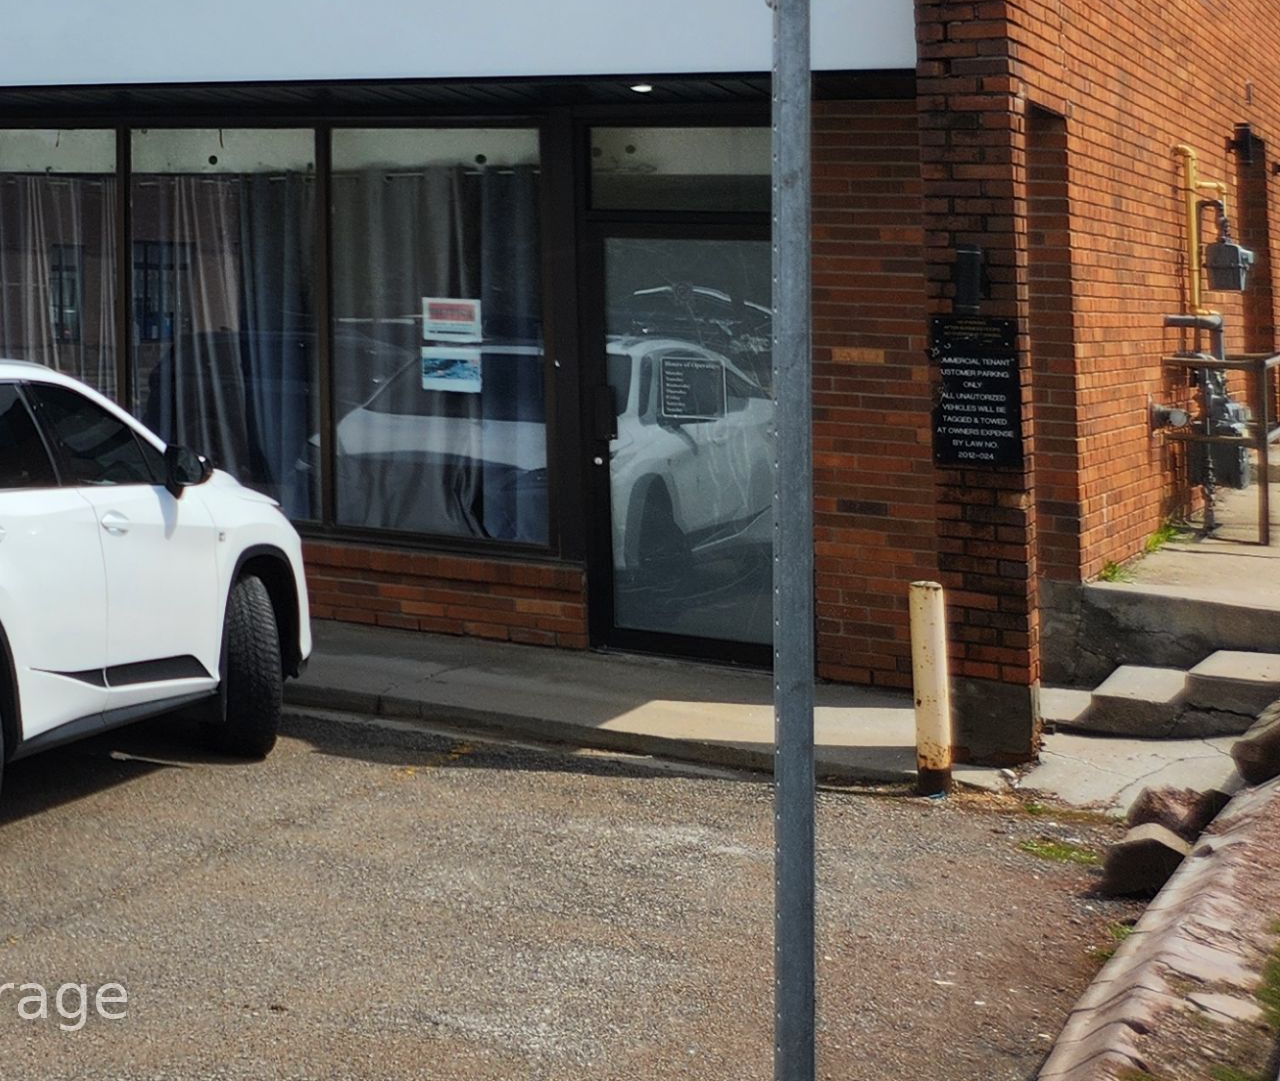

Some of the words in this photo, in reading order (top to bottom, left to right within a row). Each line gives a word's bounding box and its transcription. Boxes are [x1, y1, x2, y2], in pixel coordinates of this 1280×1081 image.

[940, 368, 976, 377] USTOMER
[976, 370, 1010, 378] PARKING
[962, 381, 982, 389] ONLY
[942, 392, 955, 400] ALL
[942, 404, 976, 412] VEHICLES
[977, 405, 995, 413] WILL
[942, 415, 973, 424] TAGGED
[980, 417, 1008, 426] TOWED
[937, 426, 947, 434] AT
[948, 427, 979, 436] OWNERS
[980, 428, 1014, 438] EXPENSE
[952, 439, 964, 447] BY
[965, 440, 983, 448] LAW
